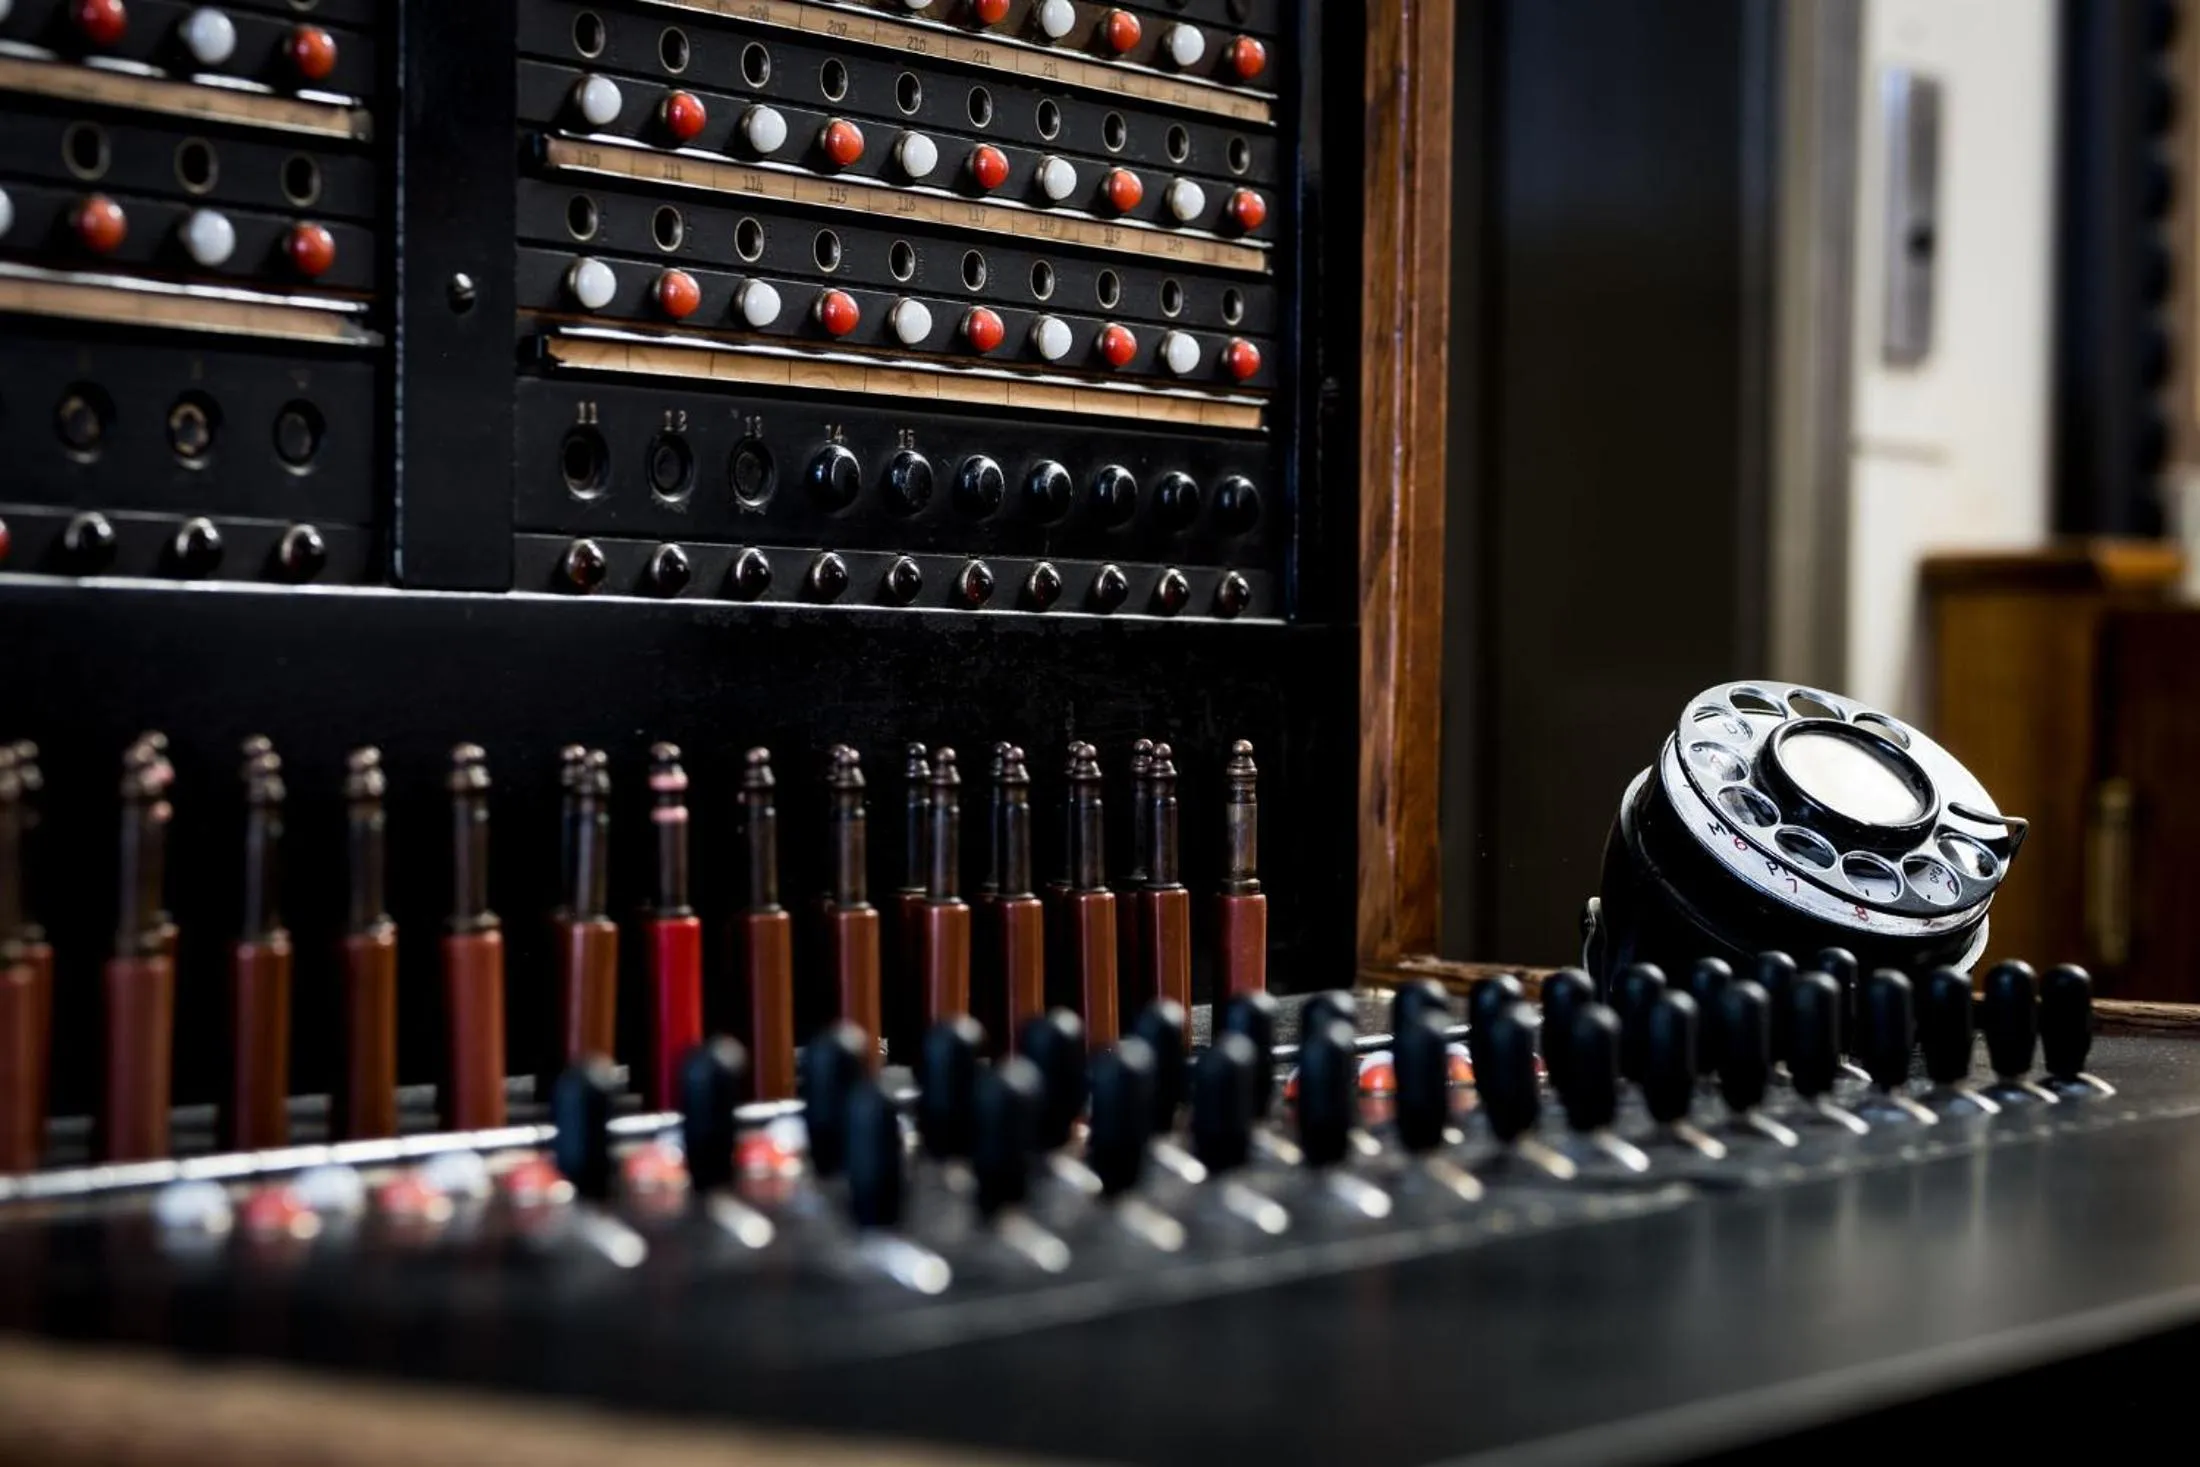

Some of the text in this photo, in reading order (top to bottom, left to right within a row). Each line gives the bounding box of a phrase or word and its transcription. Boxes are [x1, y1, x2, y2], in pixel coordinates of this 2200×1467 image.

[972, 48, 991, 65] 211
[828, 187, 847, 204] 115
[577, 401, 599, 424] 11
[825, 424, 844, 443] 14
[898, 430, 915, 449] 15
[1733, 836, 1748, 851] 6
[1785, 878, 1798, 894] 7
[1855, 906, 1869, 921] 8
